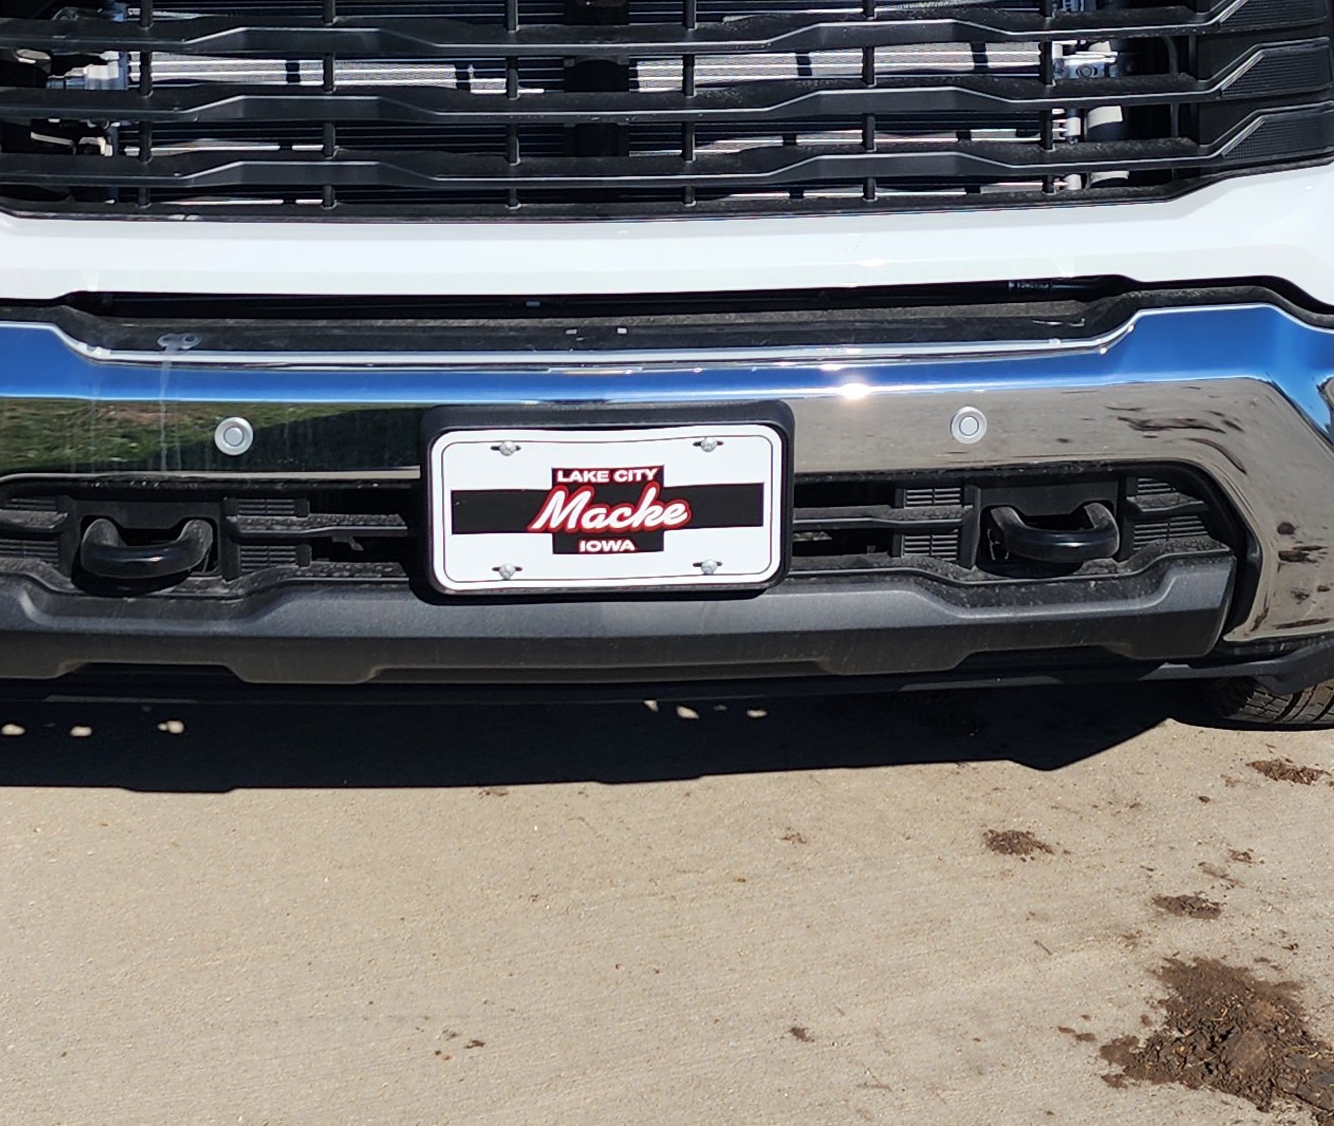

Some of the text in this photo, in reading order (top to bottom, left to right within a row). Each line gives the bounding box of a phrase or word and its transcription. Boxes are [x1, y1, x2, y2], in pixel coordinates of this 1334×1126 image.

[557, 468, 659, 483] LAKE CITY
[528, 483, 690, 531] Macke
[579, 539, 636, 553] IOWA
